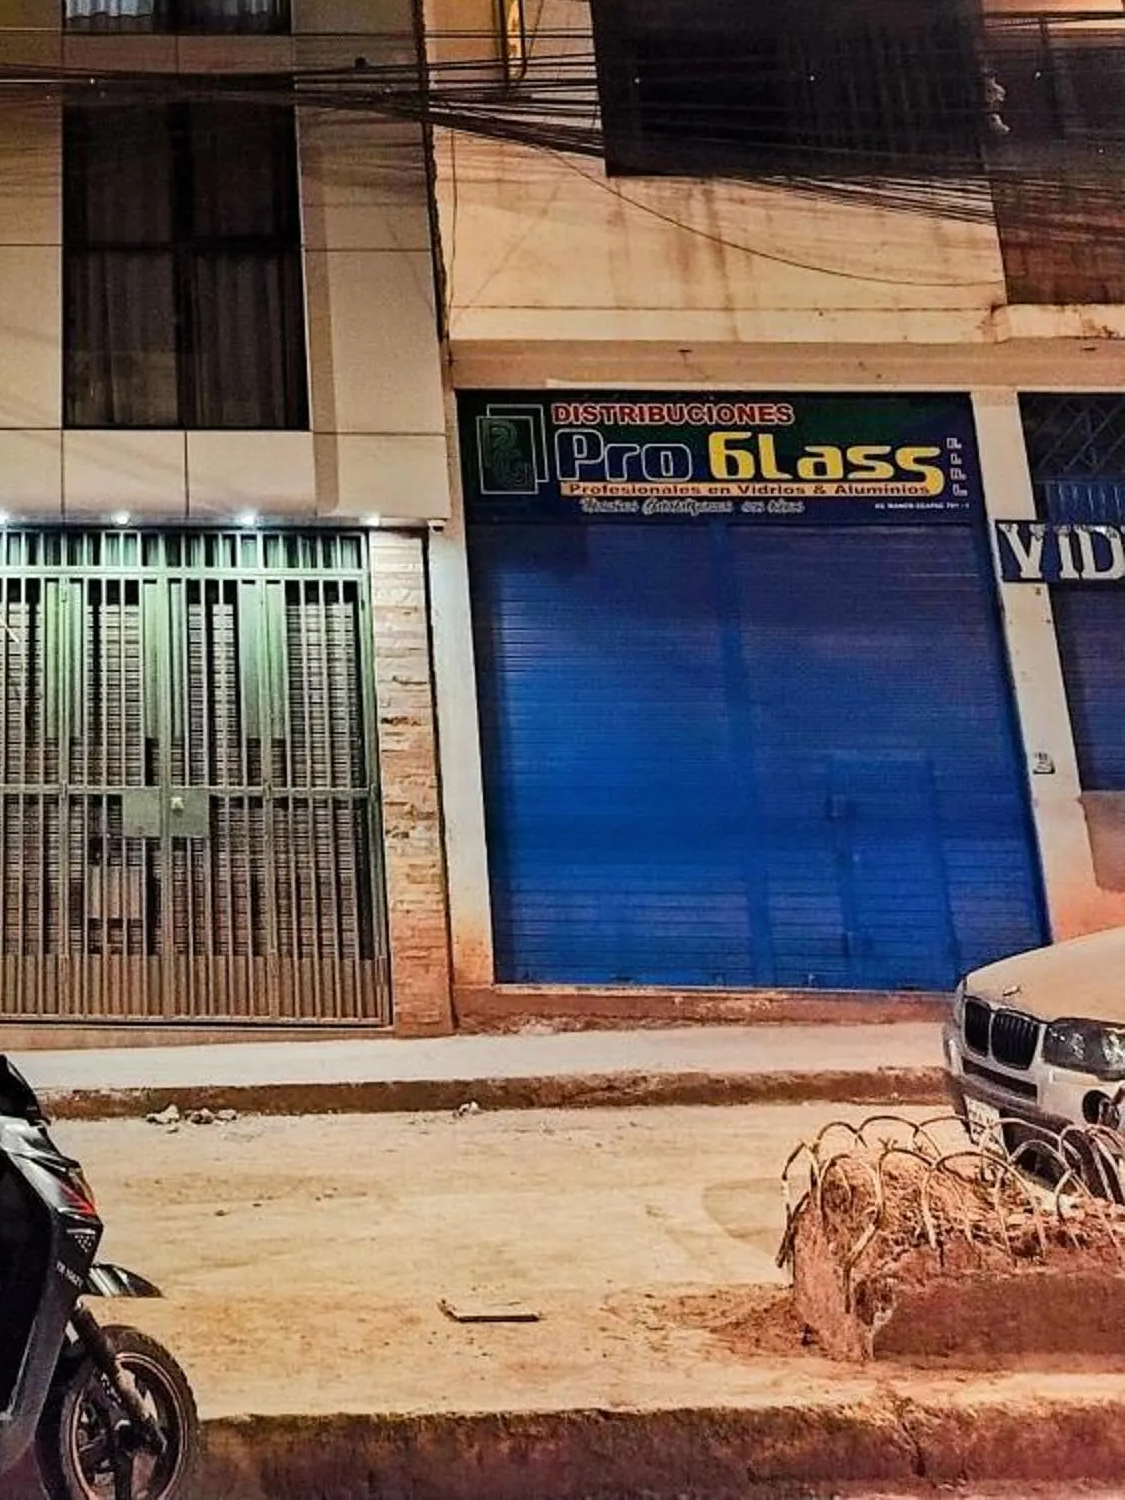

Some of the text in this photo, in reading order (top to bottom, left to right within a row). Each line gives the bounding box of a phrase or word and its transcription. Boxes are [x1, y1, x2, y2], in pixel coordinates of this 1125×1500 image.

[552, 402, 795, 426] DISTRIBUCIONES
[554, 428, 692, 483] Pro
[568, 483, 931, 496] Profesionales en Vidrios & Aluminios
